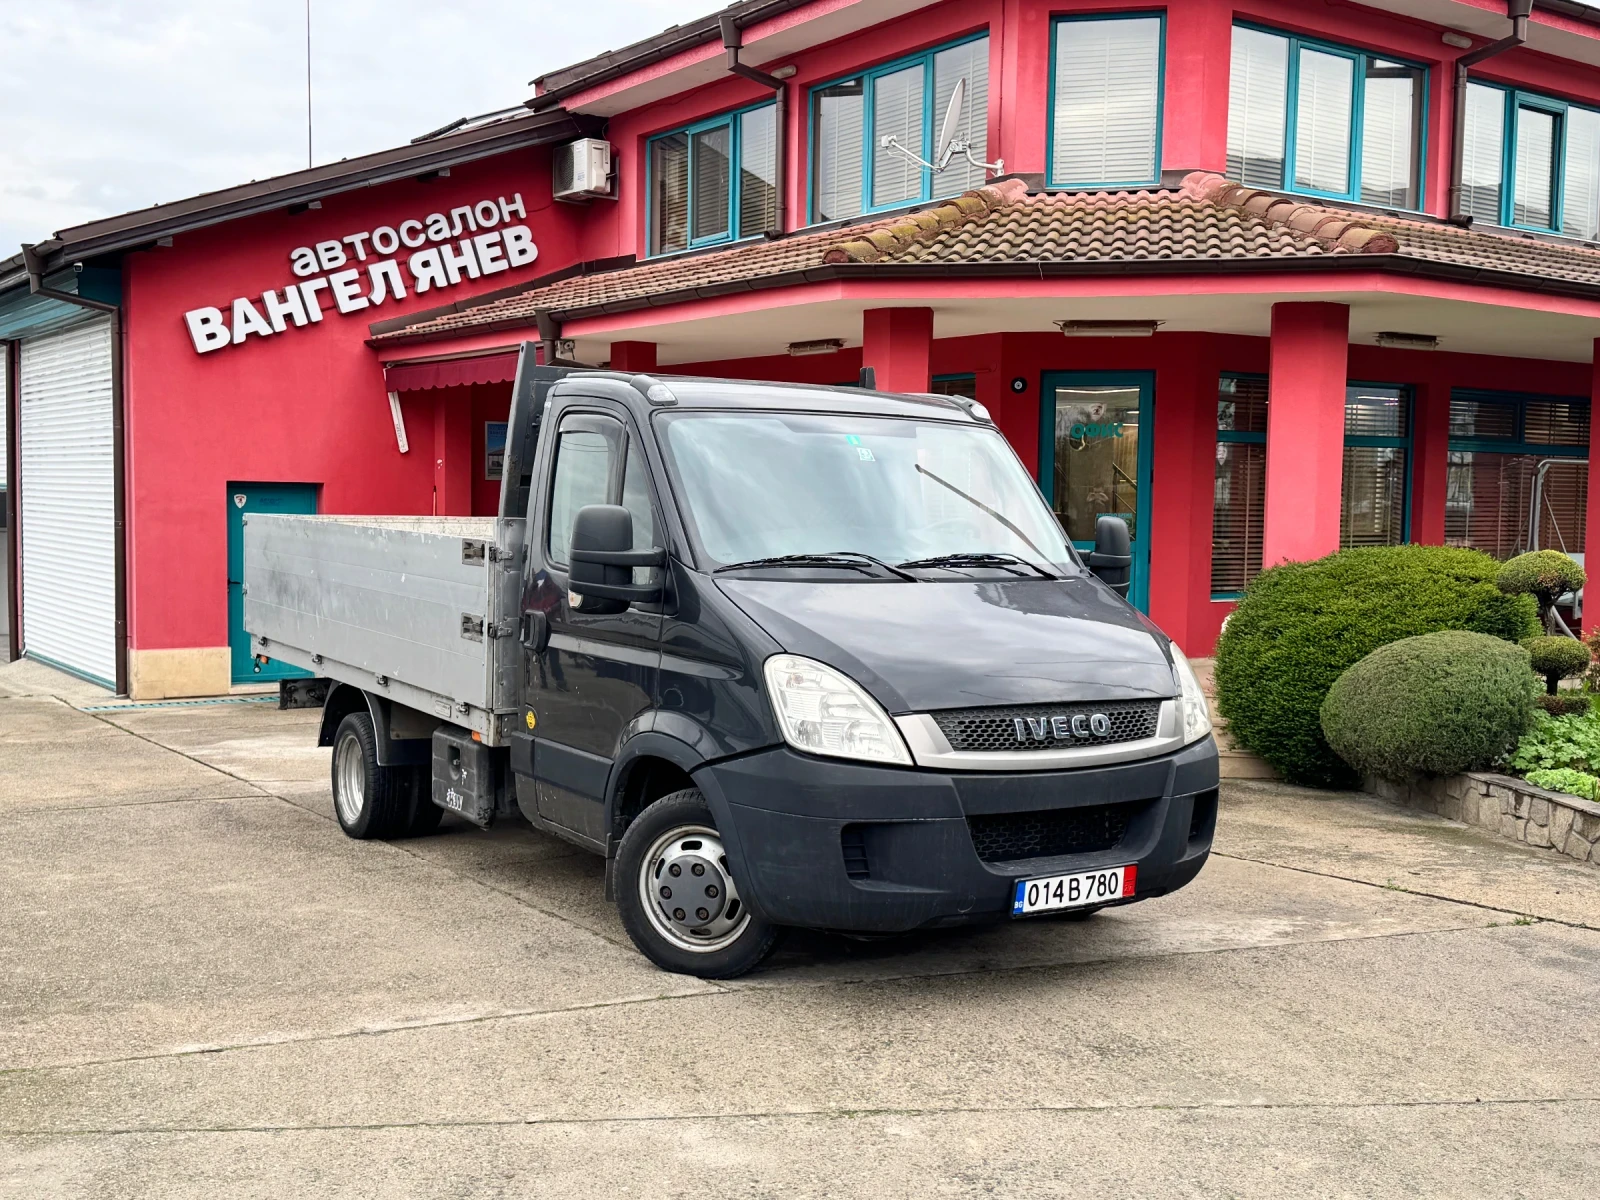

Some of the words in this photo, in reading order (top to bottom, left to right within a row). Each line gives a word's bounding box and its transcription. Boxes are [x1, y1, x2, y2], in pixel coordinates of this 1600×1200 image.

[289, 192, 527, 277] автосалон
[184, 258, 408, 354] ВАНГЕЛ
[407, 224, 539, 293] ЯНЕВ
[1014, 713, 1112, 742] IVECO
[1014, 901, 1024, 909] BG
